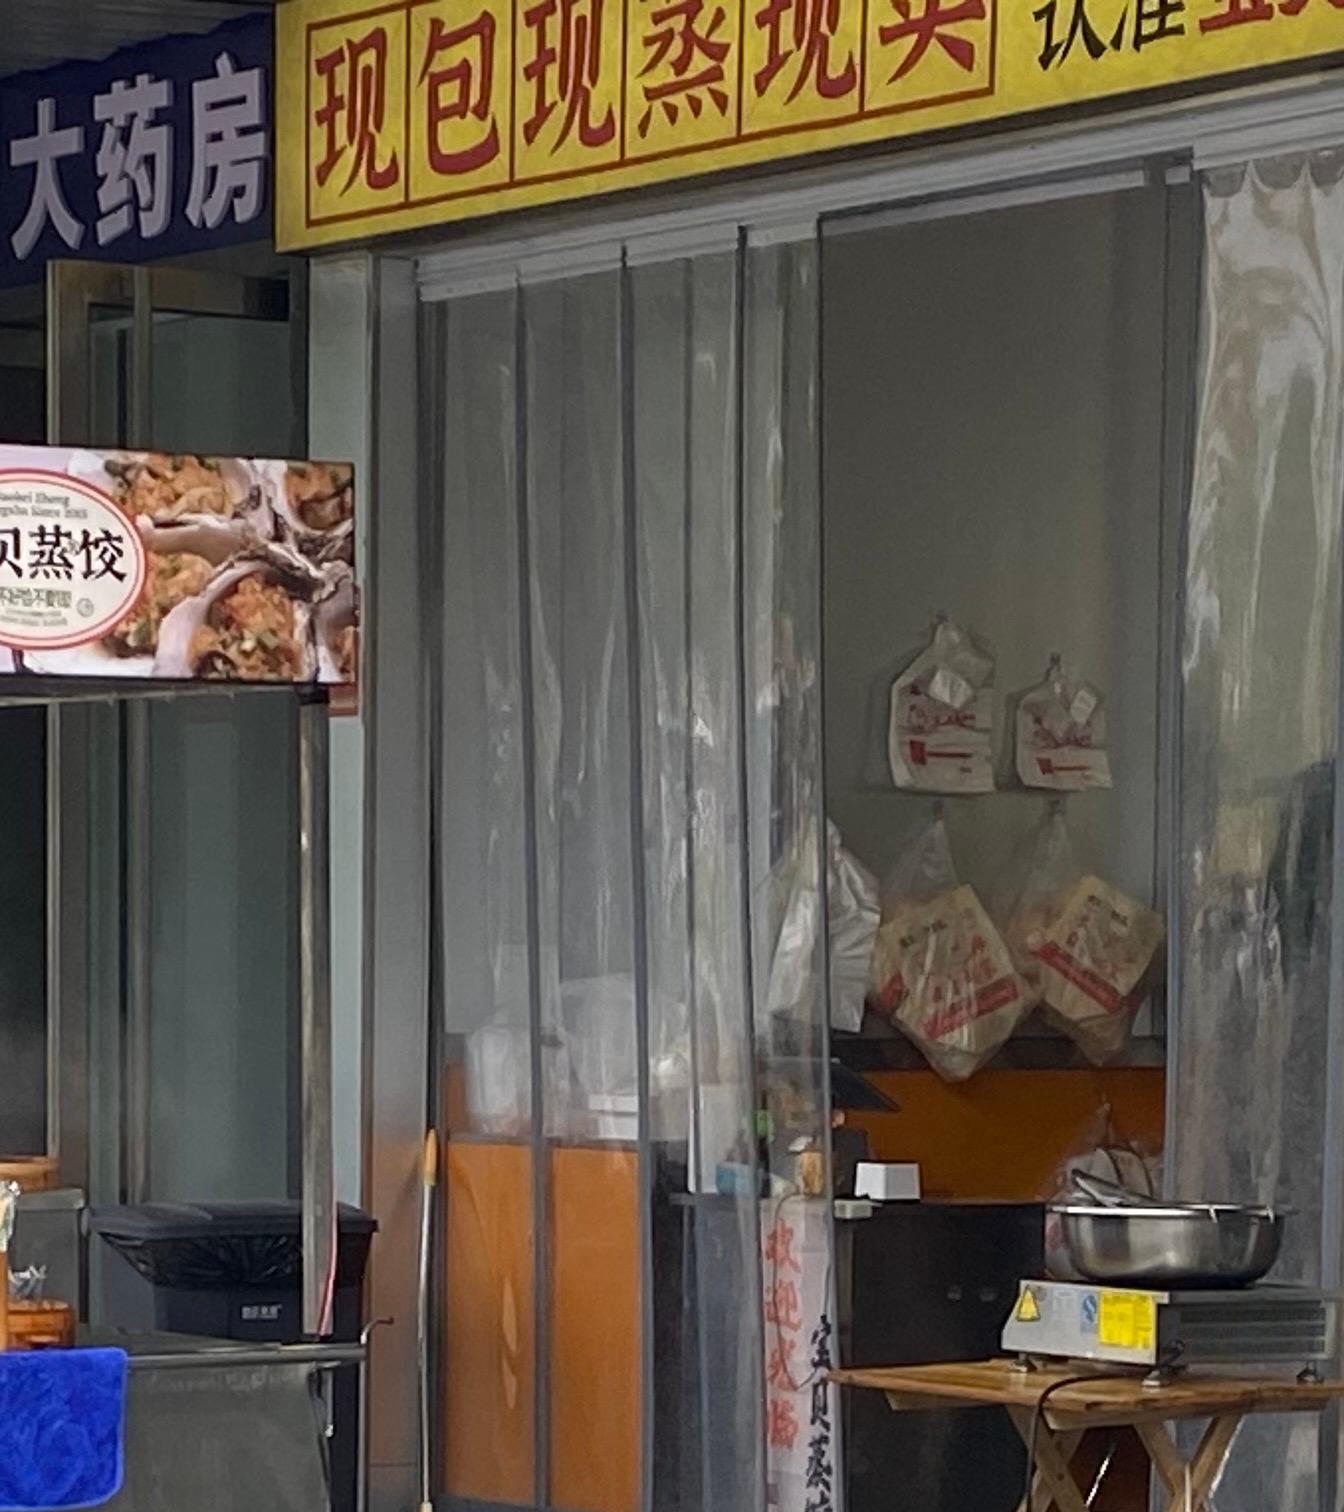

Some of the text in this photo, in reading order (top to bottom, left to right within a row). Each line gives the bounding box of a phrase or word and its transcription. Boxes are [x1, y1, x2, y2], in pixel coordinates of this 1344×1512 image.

[10, 51, 268, 260] 大药房
[764, 1217, 801, 1450] 欢迎光临
